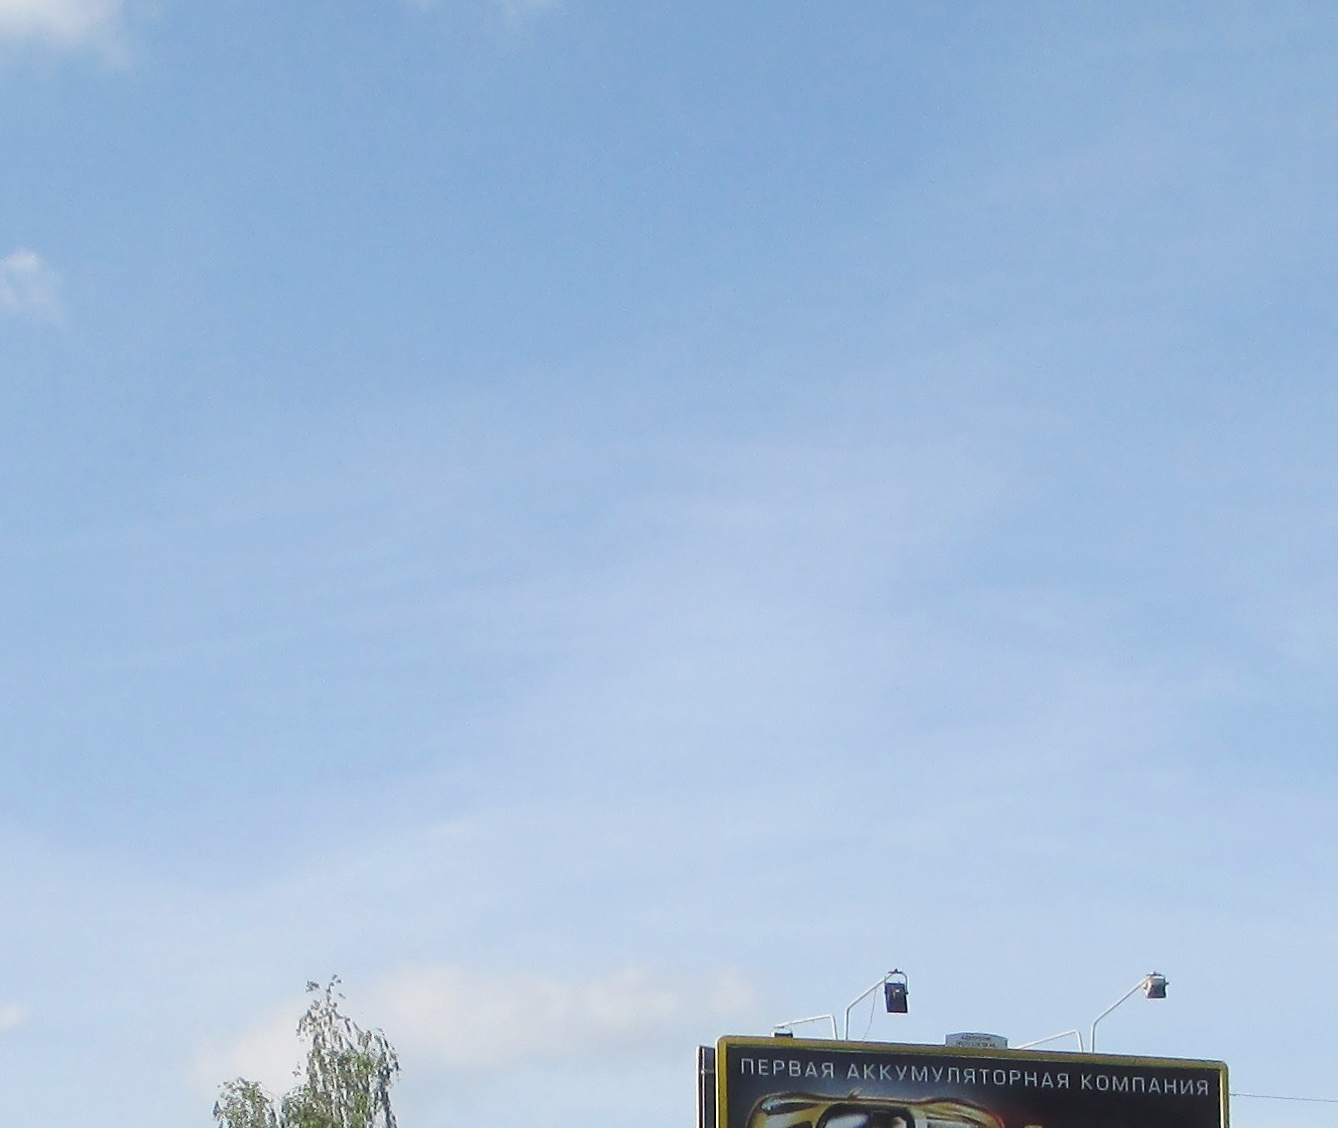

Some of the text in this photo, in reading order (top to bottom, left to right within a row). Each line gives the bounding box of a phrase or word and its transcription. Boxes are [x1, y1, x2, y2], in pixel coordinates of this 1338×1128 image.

[740, 1058, 1210, 1096] ПЕРВАЯ АККУМУЛЯТОРНАЯ КОМПАНИЯ
